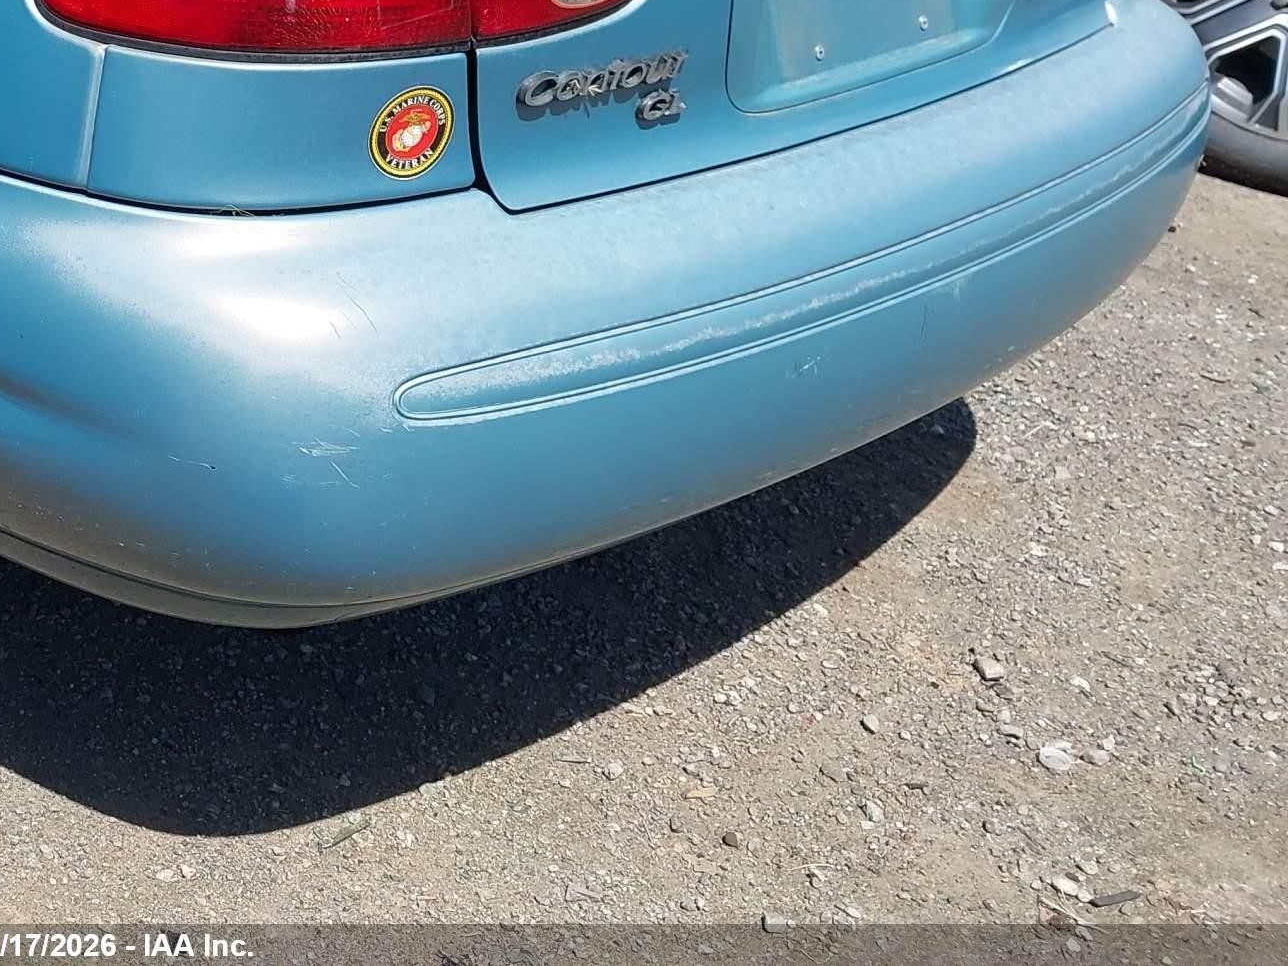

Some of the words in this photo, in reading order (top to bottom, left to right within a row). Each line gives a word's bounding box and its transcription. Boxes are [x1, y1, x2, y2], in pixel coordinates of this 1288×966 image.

[379, 117, 394, 133] U.S.
[392, 95, 431, 115] MARINE
[429, 98, 446, 126] CORPS
[385, 147, 434, 170] VETERAN
